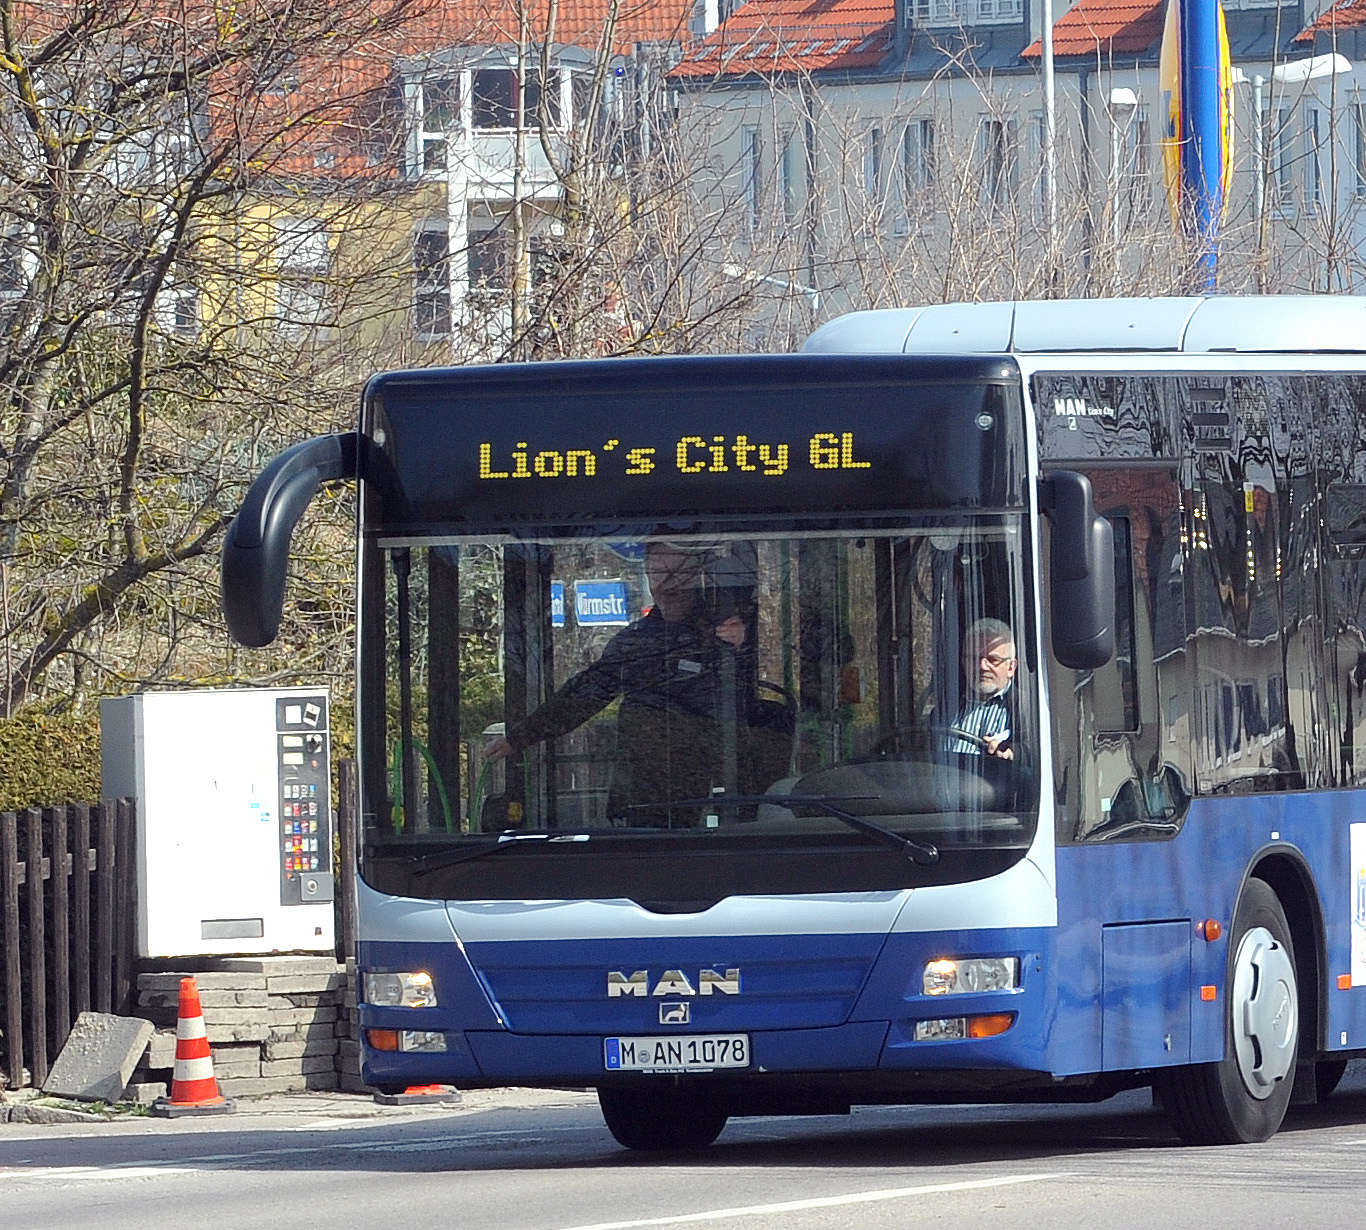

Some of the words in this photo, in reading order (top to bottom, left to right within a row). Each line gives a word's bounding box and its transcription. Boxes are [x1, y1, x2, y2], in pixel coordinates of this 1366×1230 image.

[1054, 398, 1087, 416] MAN
[676, 434, 789, 476] City
[607, 967, 740, 998] MAN
